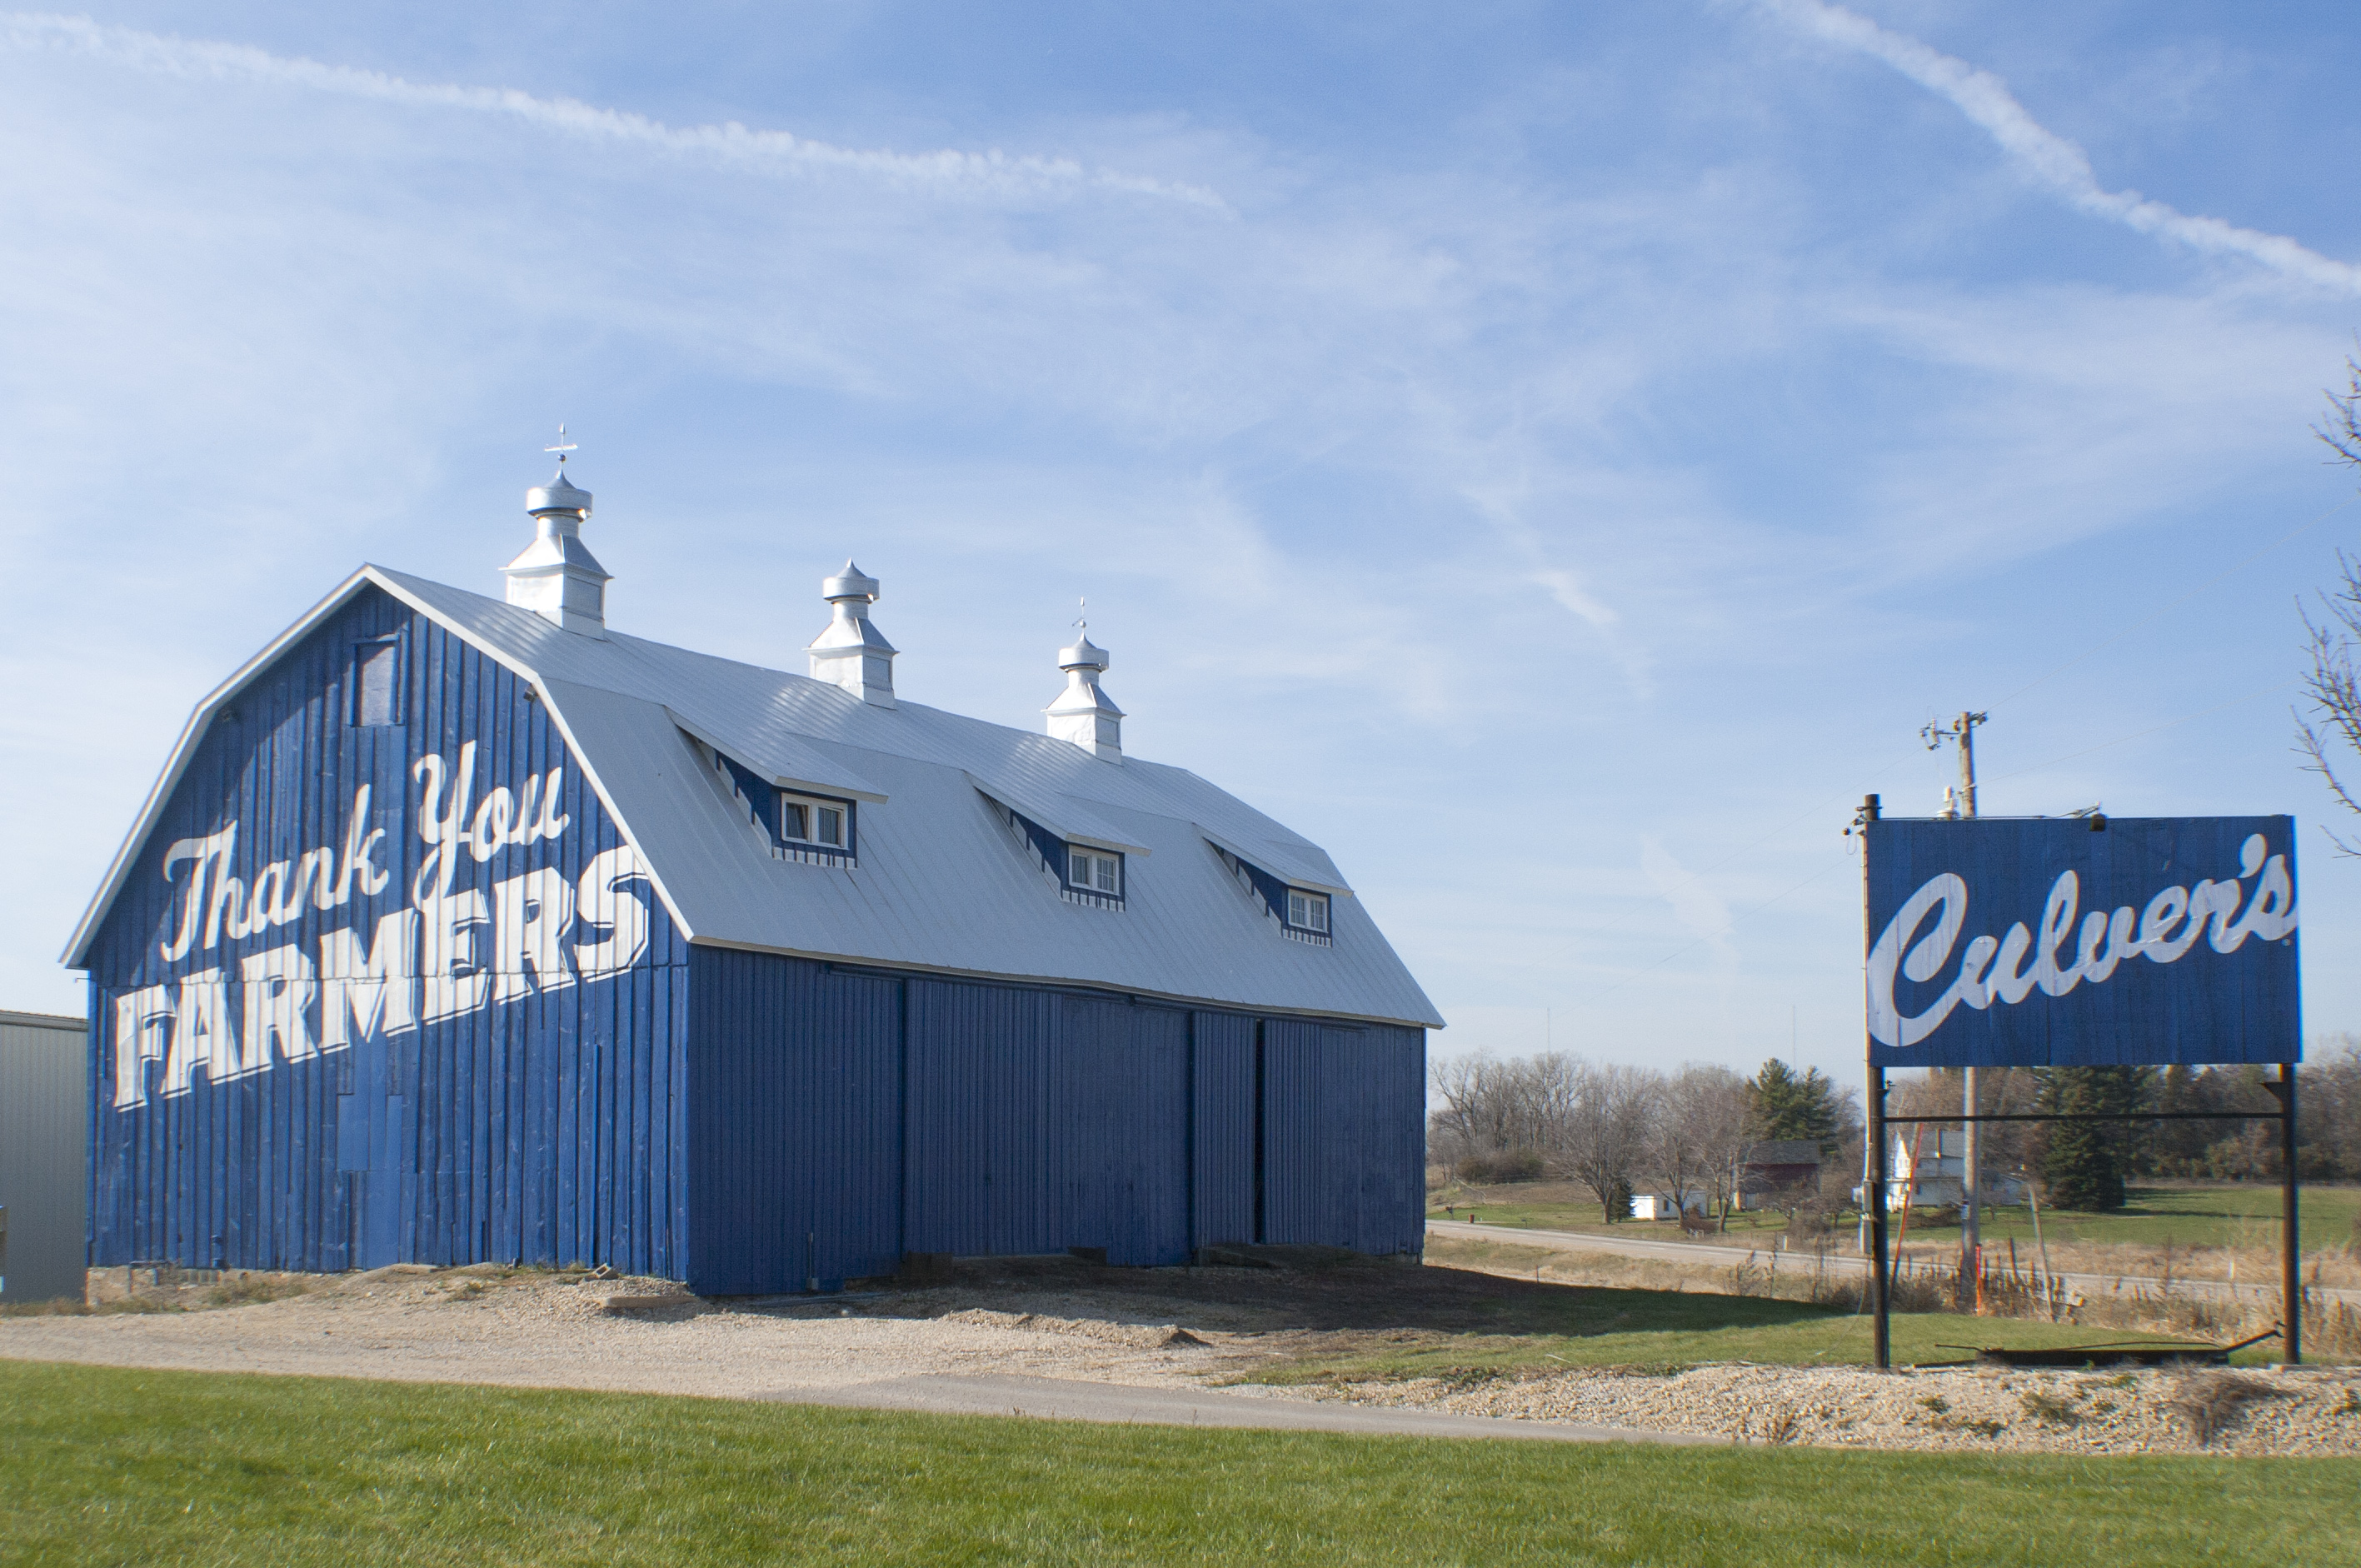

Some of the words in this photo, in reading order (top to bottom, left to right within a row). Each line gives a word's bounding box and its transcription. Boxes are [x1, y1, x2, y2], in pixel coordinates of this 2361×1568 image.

[161, 783, 390, 962] Thank
[413, 740, 570, 911] You
[1867, 833, 2298, 1046] Culver's
[113, 845, 649, 1113] FARMERS
